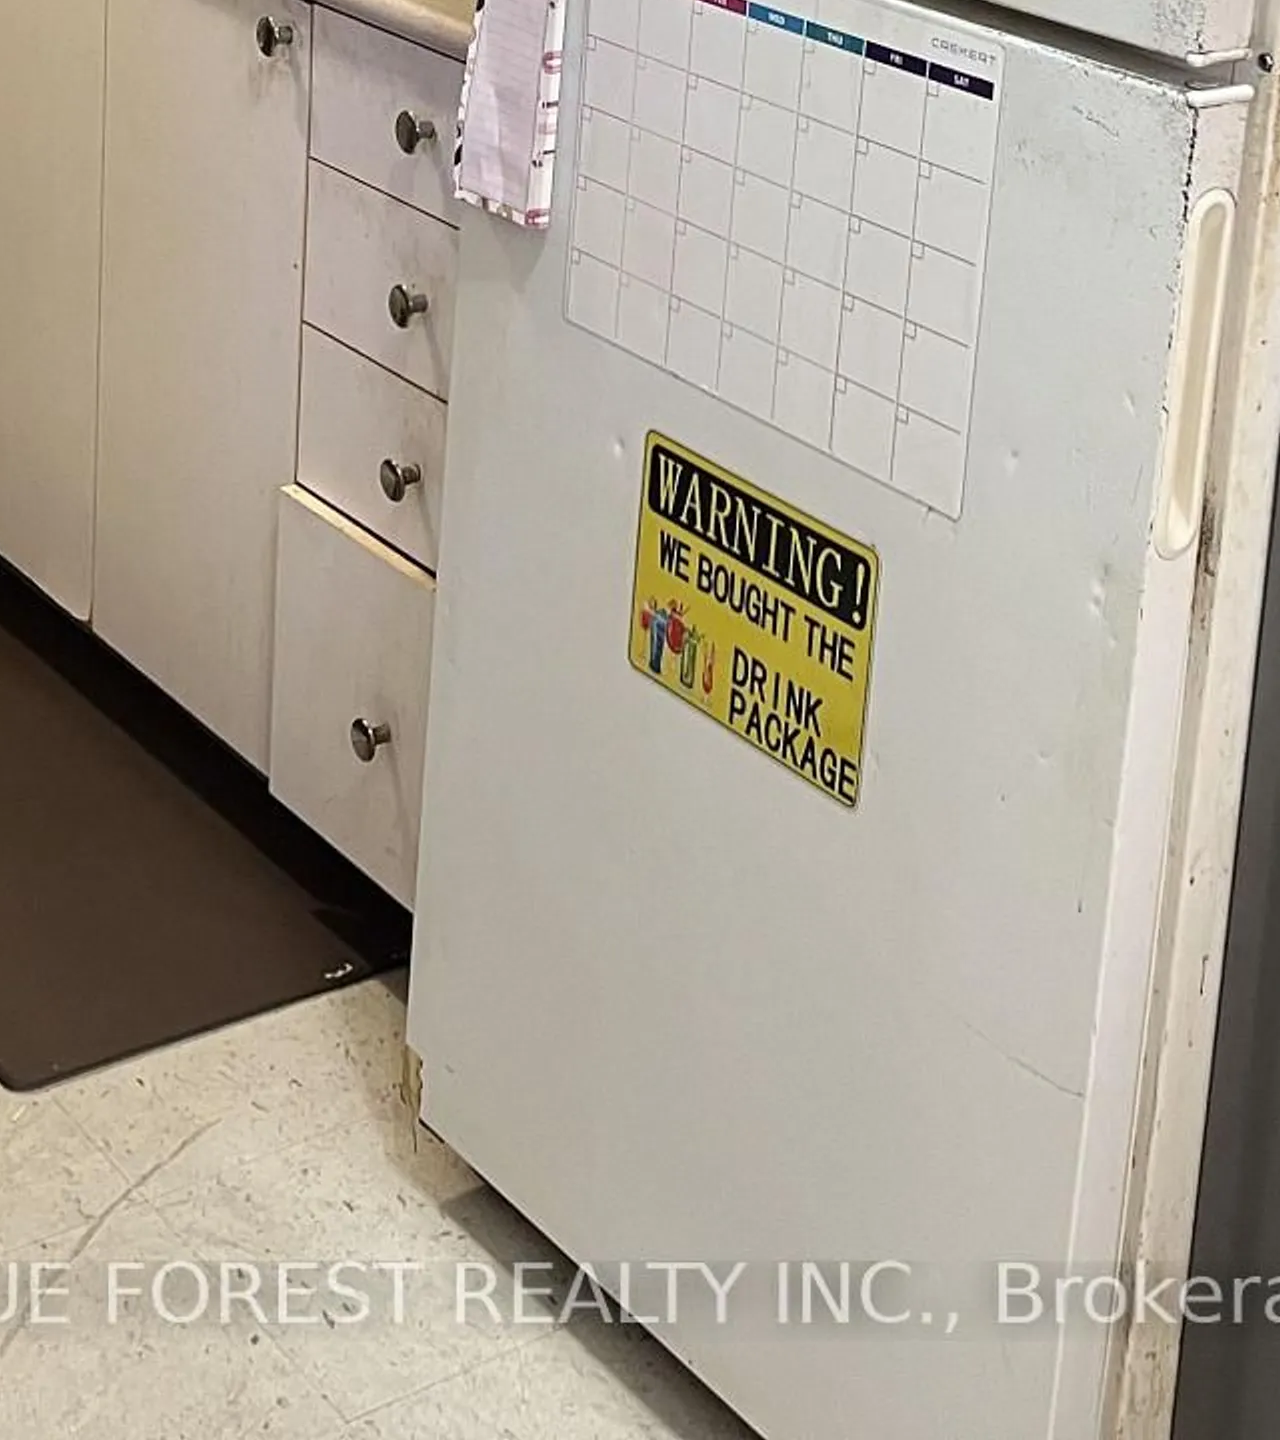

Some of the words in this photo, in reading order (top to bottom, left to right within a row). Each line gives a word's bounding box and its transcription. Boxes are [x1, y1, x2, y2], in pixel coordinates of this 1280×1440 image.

[658, 452, 868, 626] WARNING!
[659, 529, 691, 584] WE
[697, 553, 797, 643] BOUGHT
[805, 615, 856, 681] THE
[728, 690, 857, 803] PACKAGE
[732, 645, 823, 737] DRINK
